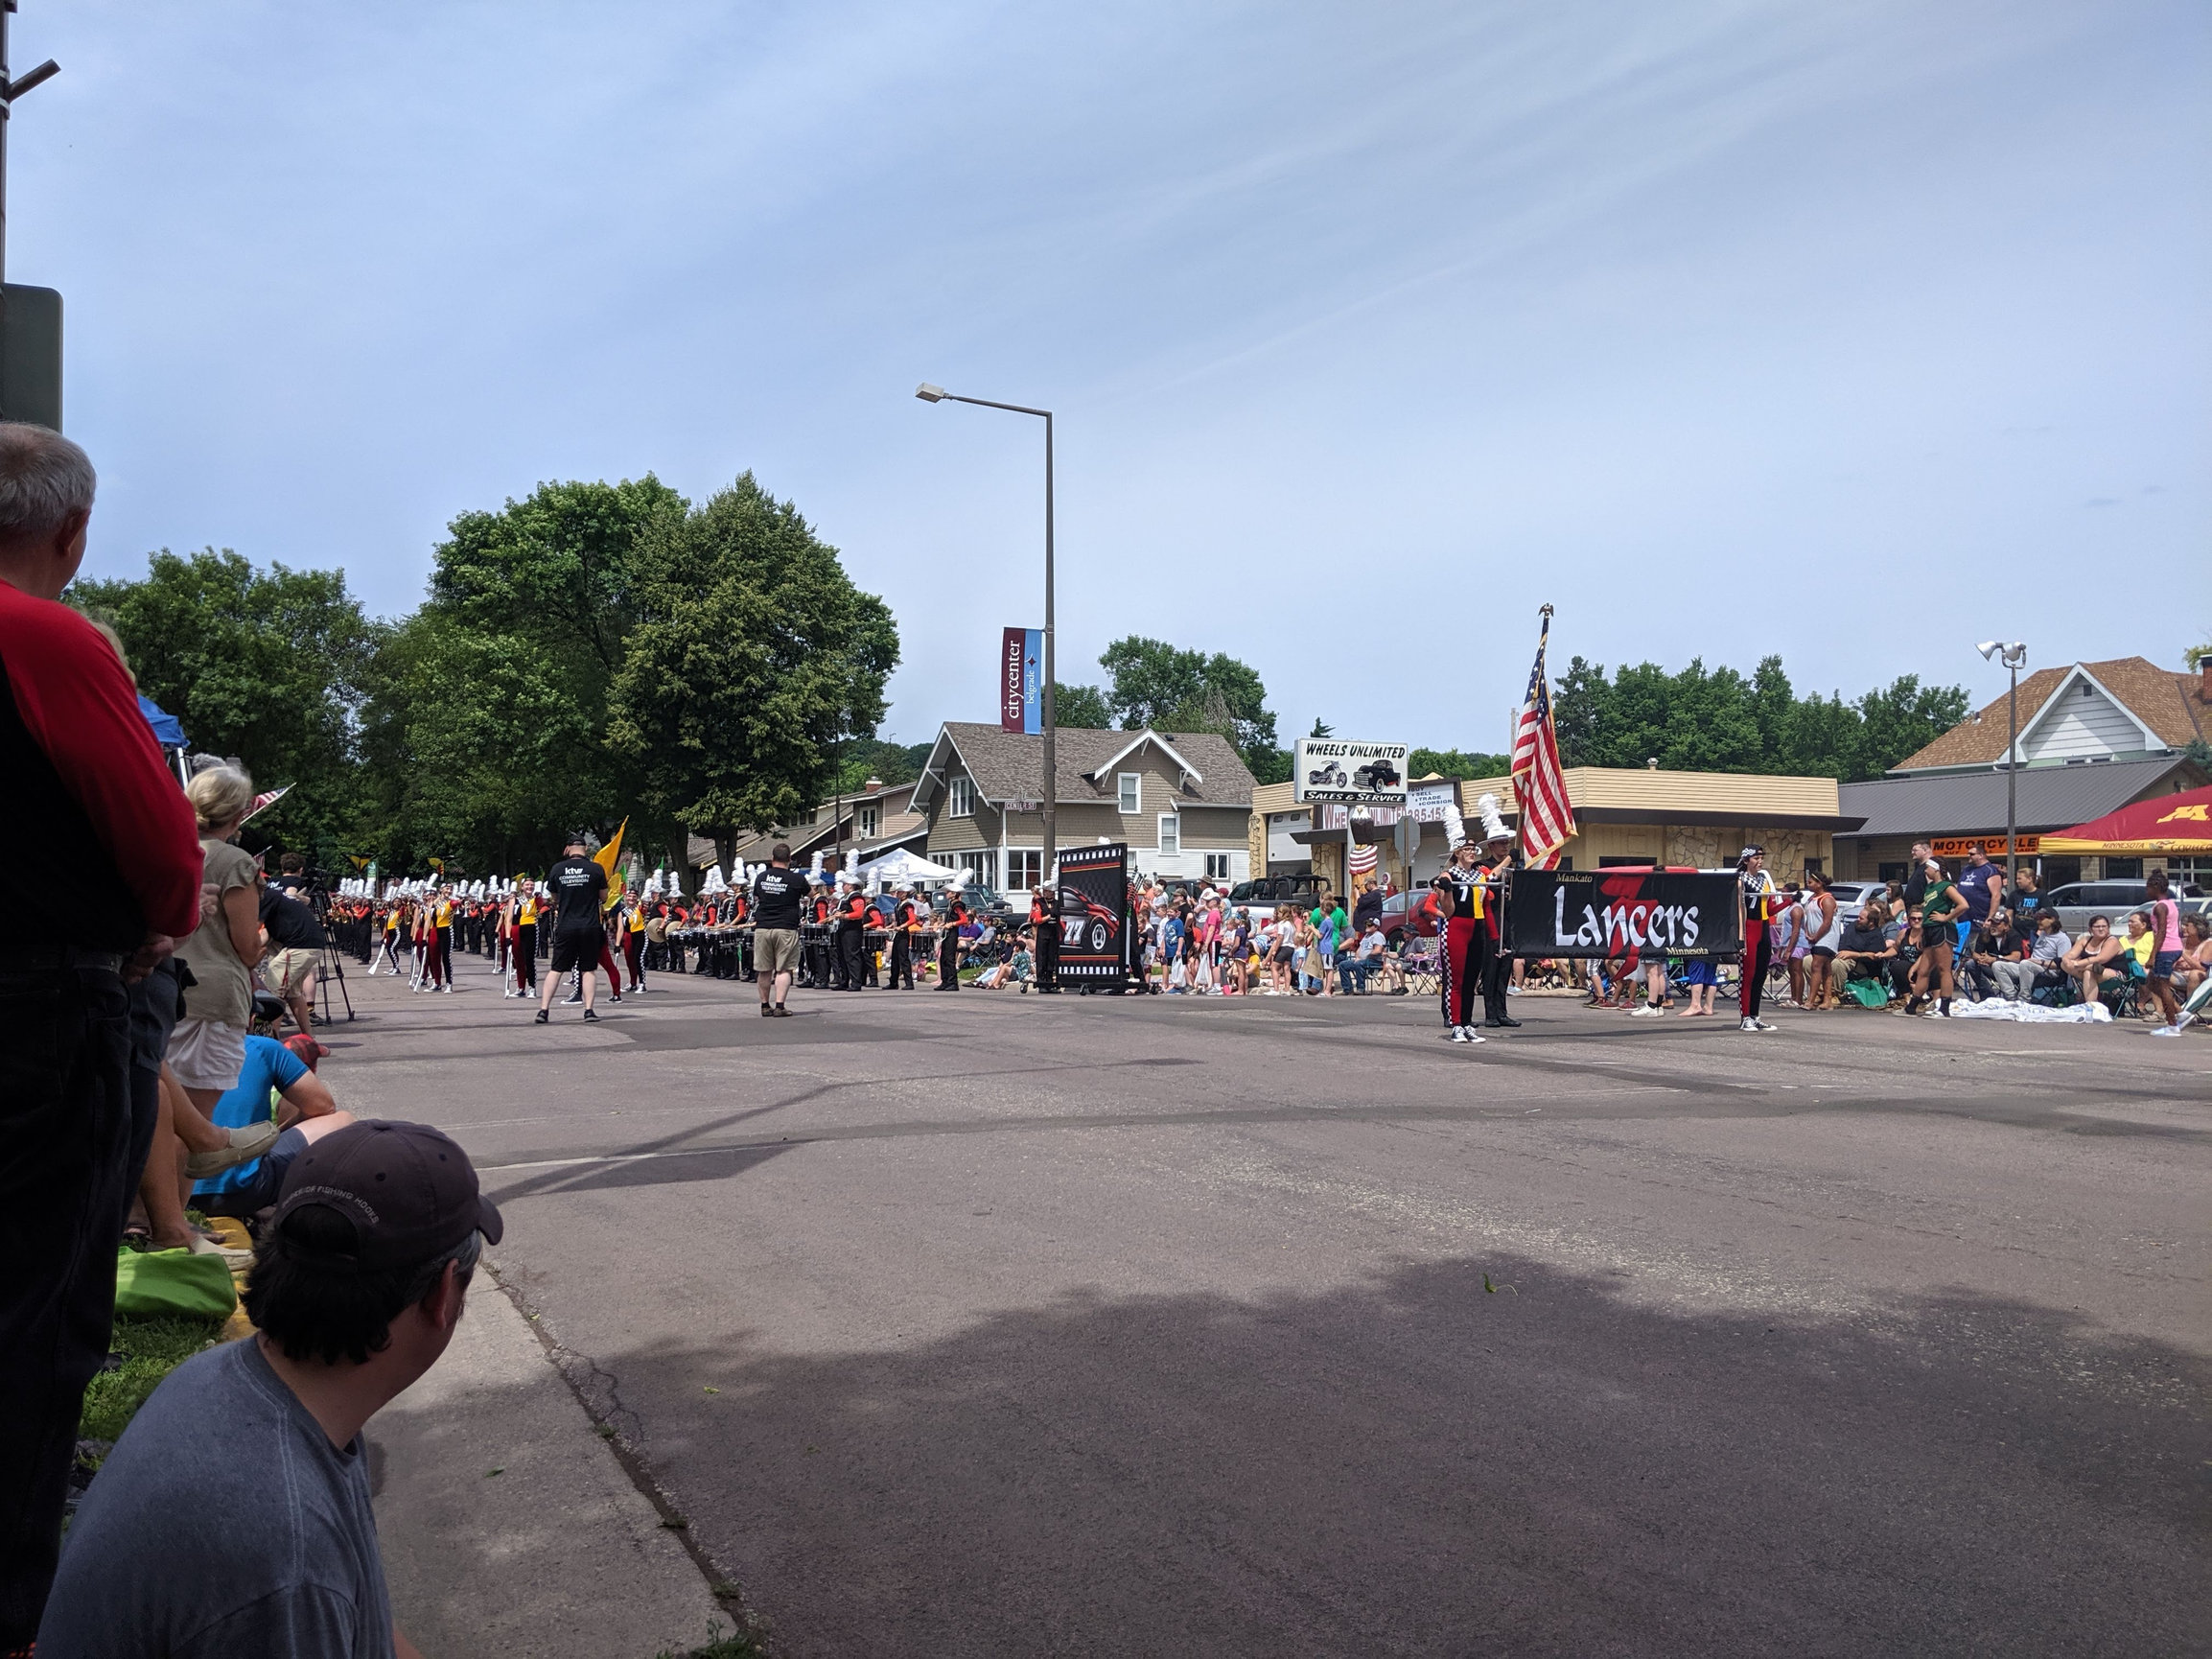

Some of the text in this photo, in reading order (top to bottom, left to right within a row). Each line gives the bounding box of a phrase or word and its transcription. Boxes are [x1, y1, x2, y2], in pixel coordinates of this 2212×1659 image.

[1004, 640, 1024, 719] citycenter
[1026, 669, 1036, 705] belgrade
[1306, 742, 1406, 759] WHEELS UNLIMITED
[1306, 791, 1342, 800] SALES
[1356, 792, 1404, 802] SERVICE
[1555, 874, 1593, 883] Mankato
[1459, 885, 1468, 902] 7
[1749, 895, 1758, 909] 7
[525, 903, 532, 914] 7
[1553, 885, 1700, 948] Lancers
[1064, 920, 1085, 945] 77
[1665, 946, 1709, 955] Minnesota
[317, 1185, 354, 1200] FISHING
[354, 1197, 380, 1224] HOOKS
